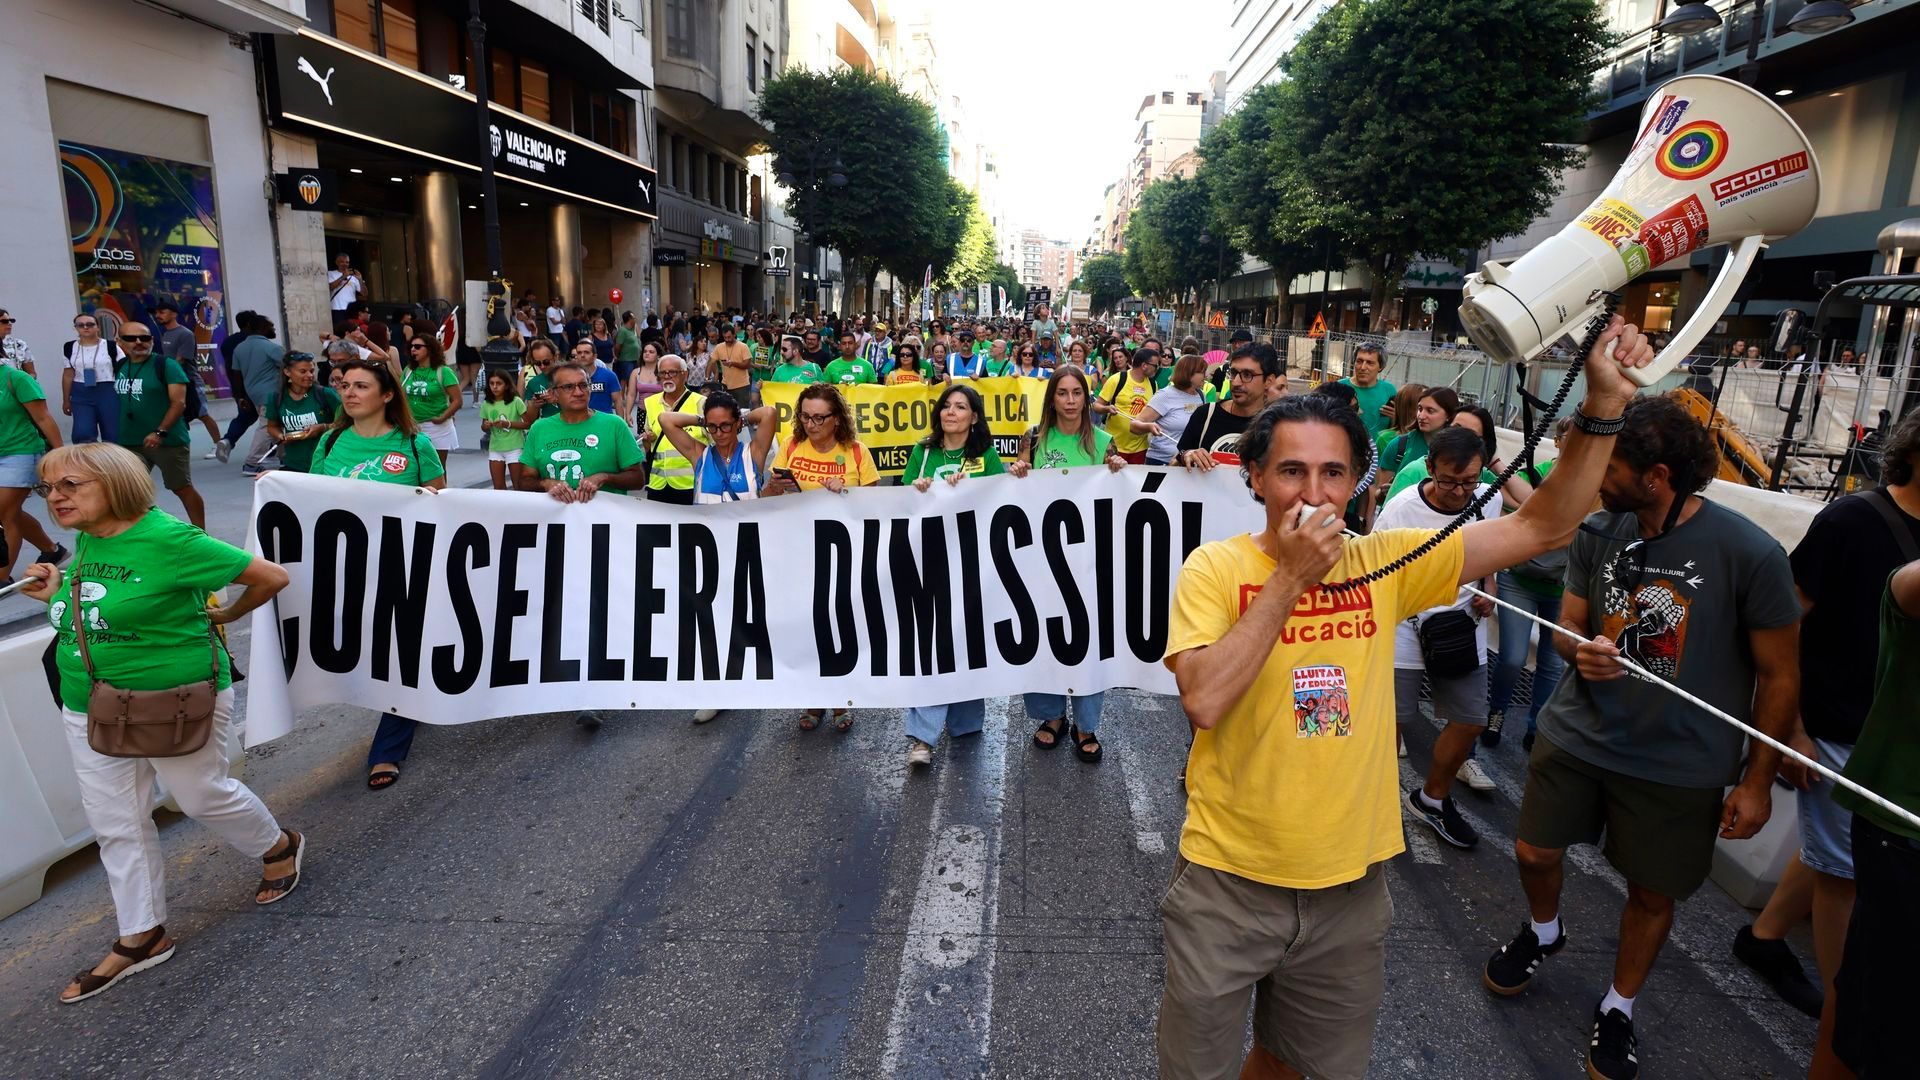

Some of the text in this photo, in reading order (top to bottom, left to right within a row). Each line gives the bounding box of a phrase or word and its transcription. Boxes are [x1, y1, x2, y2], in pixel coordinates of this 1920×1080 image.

[505, 129, 567, 167] VALENCIA CF
[506, 152, 546, 173] OFFICIAL STORE
[1715, 165, 1777, 196] CCOO
[1719, 181, 1779, 207] país valencià
[1591, 215, 1634, 249] 23M
[93, 246, 136, 261] IQOS
[170, 252, 201, 266] VEEV
[91, 263, 141, 272] CALIENTA TABACO
[591, 383, 605, 391] ESEL
[385, 454, 407, 467] UGT
[878, 445, 908, 467] MÉS
[792, 459, 828, 473] CCOO
[1629, 564, 1686, 577] PALTINA LLIURE
[256, 500, 774, 695] CONSELLERA
[1280, 612, 1377, 645] ucació
[1294, 668, 1343, 680] LLUITAR
[1308, 679, 1345, 688] EDUCAR
